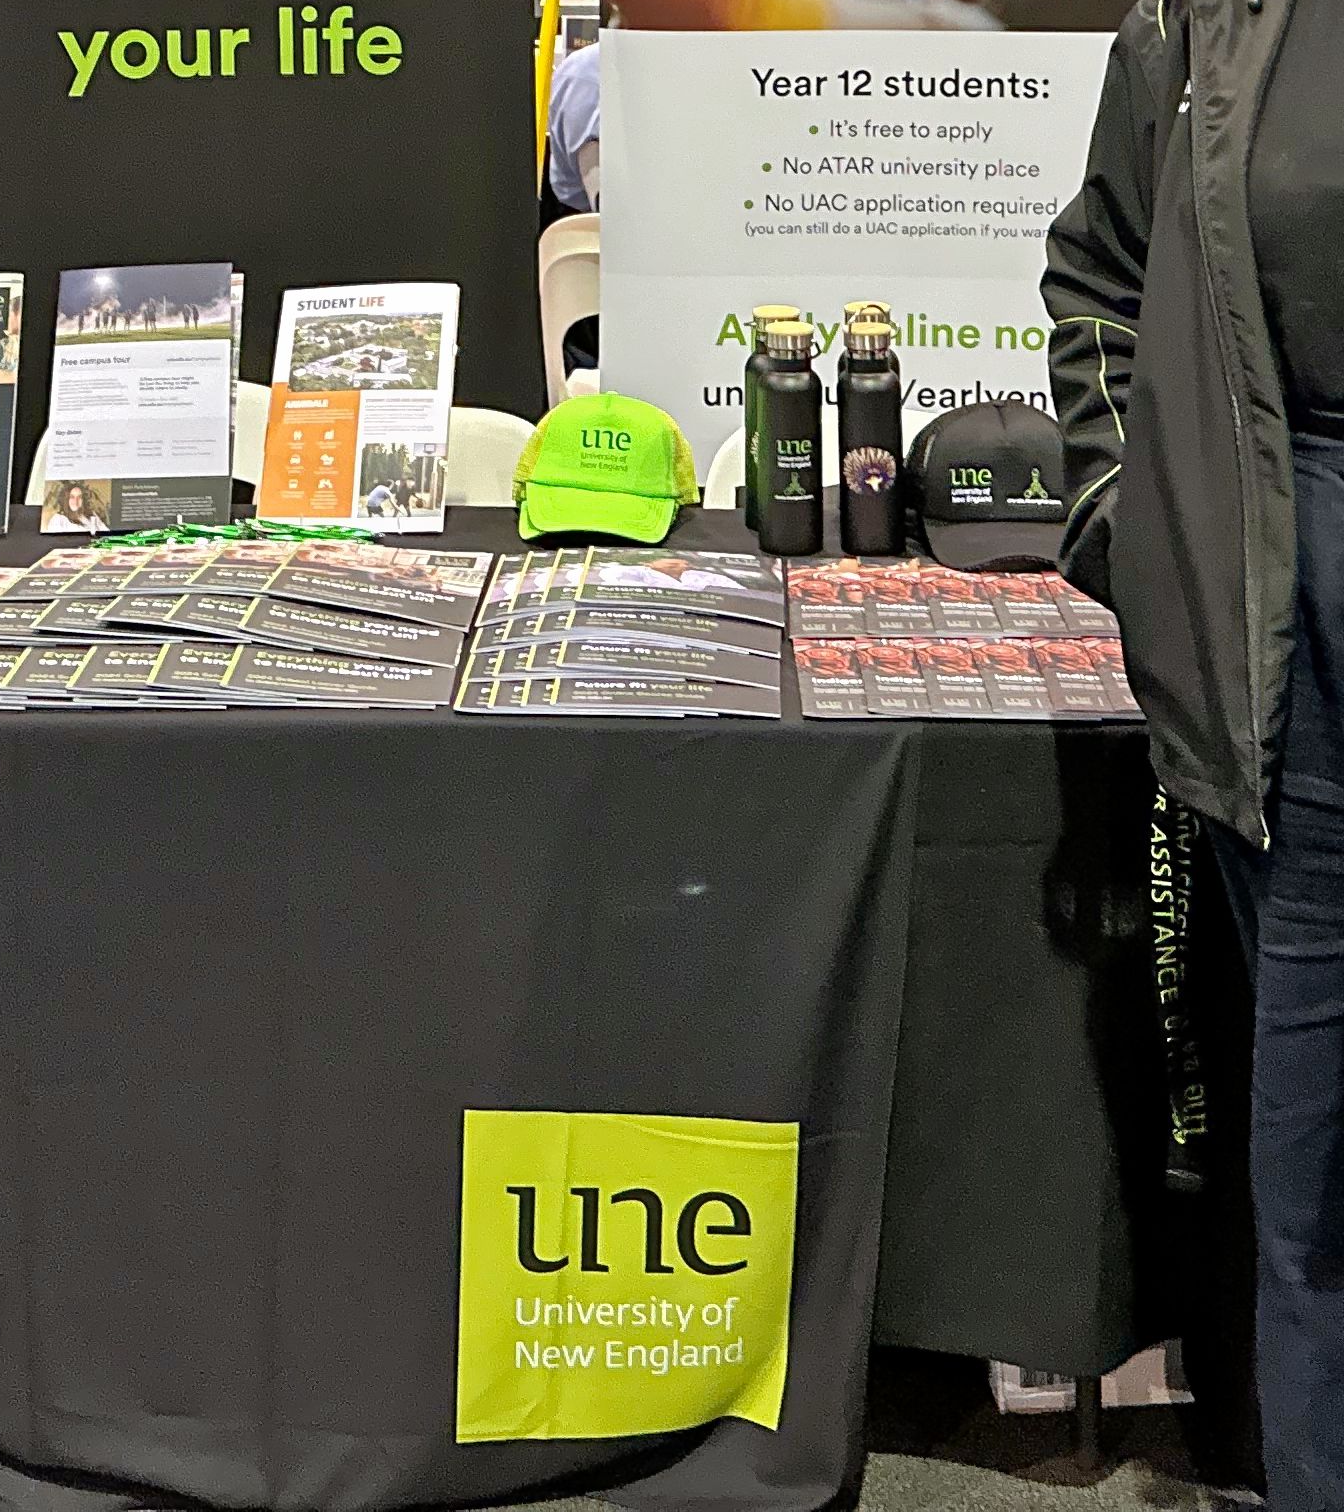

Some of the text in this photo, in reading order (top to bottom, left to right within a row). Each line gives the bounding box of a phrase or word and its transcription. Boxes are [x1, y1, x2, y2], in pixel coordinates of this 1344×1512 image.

[59, 5, 403, 97] your life
[752, 68, 1050, 99] Year 12 students:
[830, 119, 993, 143] It's free to apply
[783, 158, 1041, 180] No ATAR university place
[765, 194, 1058, 218] No UAC application required
[745, 222, 1018, 240] (you can still do a UAC application if you
[297, 296, 385, 311] STUDENT LIFE
[995, 326, 1056, 351] no
[581, 430, 631, 451] une
[777, 439, 812, 454] une
[948, 468, 993, 486] une
[1151, 822, 1179, 1004] ASSISTANCE
[506, 1186, 752, 1276] une
[515, 1294, 740, 1333] University of
[515, 1337, 744, 1375] New England
